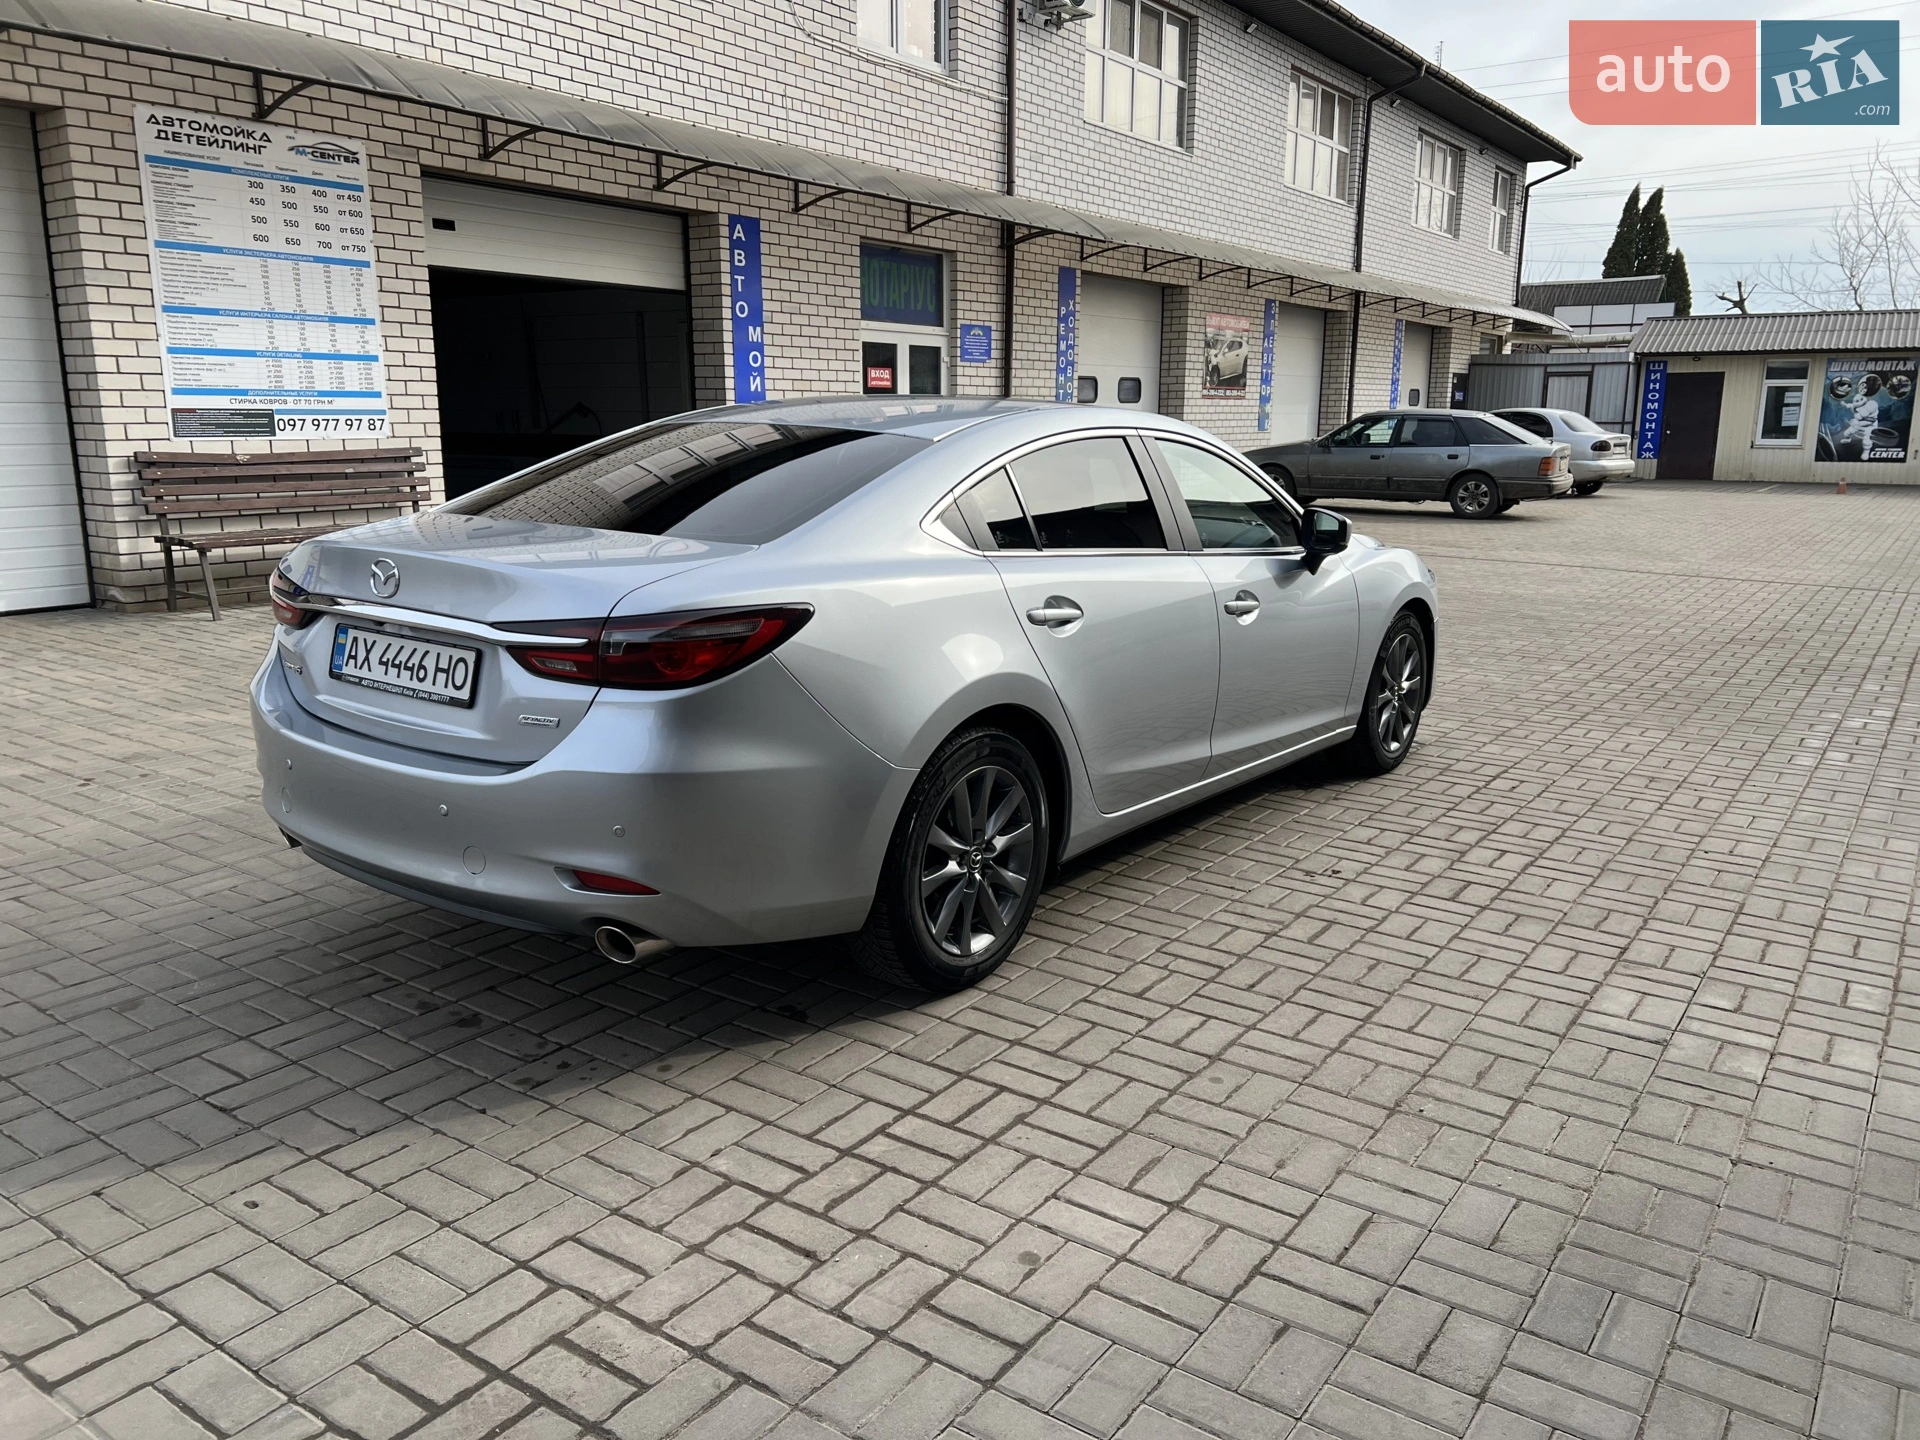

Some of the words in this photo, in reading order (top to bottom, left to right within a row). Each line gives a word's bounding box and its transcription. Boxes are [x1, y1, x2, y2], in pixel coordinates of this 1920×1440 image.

[146, 113, 273, 143] АВТОМОЙКА
[154, 129, 267, 155] ДЕТЕЙЛИНГ
[294, 147, 360, 165] M-CENTER
[247, 179, 264, 190] 300
[280, 184, 296, 194] 350
[311, 189, 327, 198] 400
[347, 194, 362, 203] 450
[249, 197, 266, 206] 450
[281, 201, 297, 210] 500
[313, 205, 329, 214] 550
[348, 209, 363, 218] 600
[251, 215, 267, 225] 500
[283, 219, 299, 228] 550
[315, 222, 330, 232] 600
[350, 227, 365, 236] 650
[253, 233, 269, 243] 600
[285, 237, 301, 246] 650
[317, 241, 332, 249] 700
[351, 244, 366, 253] 750
[243, 250, 278, 258] ЭКСТЕРЬЕРА
[748, 325, 762, 402] МОЙ
[871, 369, 890, 379] ВХОД
[1830, 360, 1917, 371] ШИНОМОНТАЖ
[1641, 362, 1663, 458] ШИНОМОНТАЖ
[276, 418, 306, 432] 097
[311, 418, 340, 431] 977
[344, 418, 363, 431] 97
[367, 418, 385, 431] 87
[1870, 451, 1905, 459] CENTER
[334, 655, 342, 666] UA
[345, 636, 377, 672] AX
[378, 642, 430, 683] 4446
[432, 652, 469, 691] HO
[361, 679, 373, 687] АВТО
[417, 690, 430, 700] (044)
